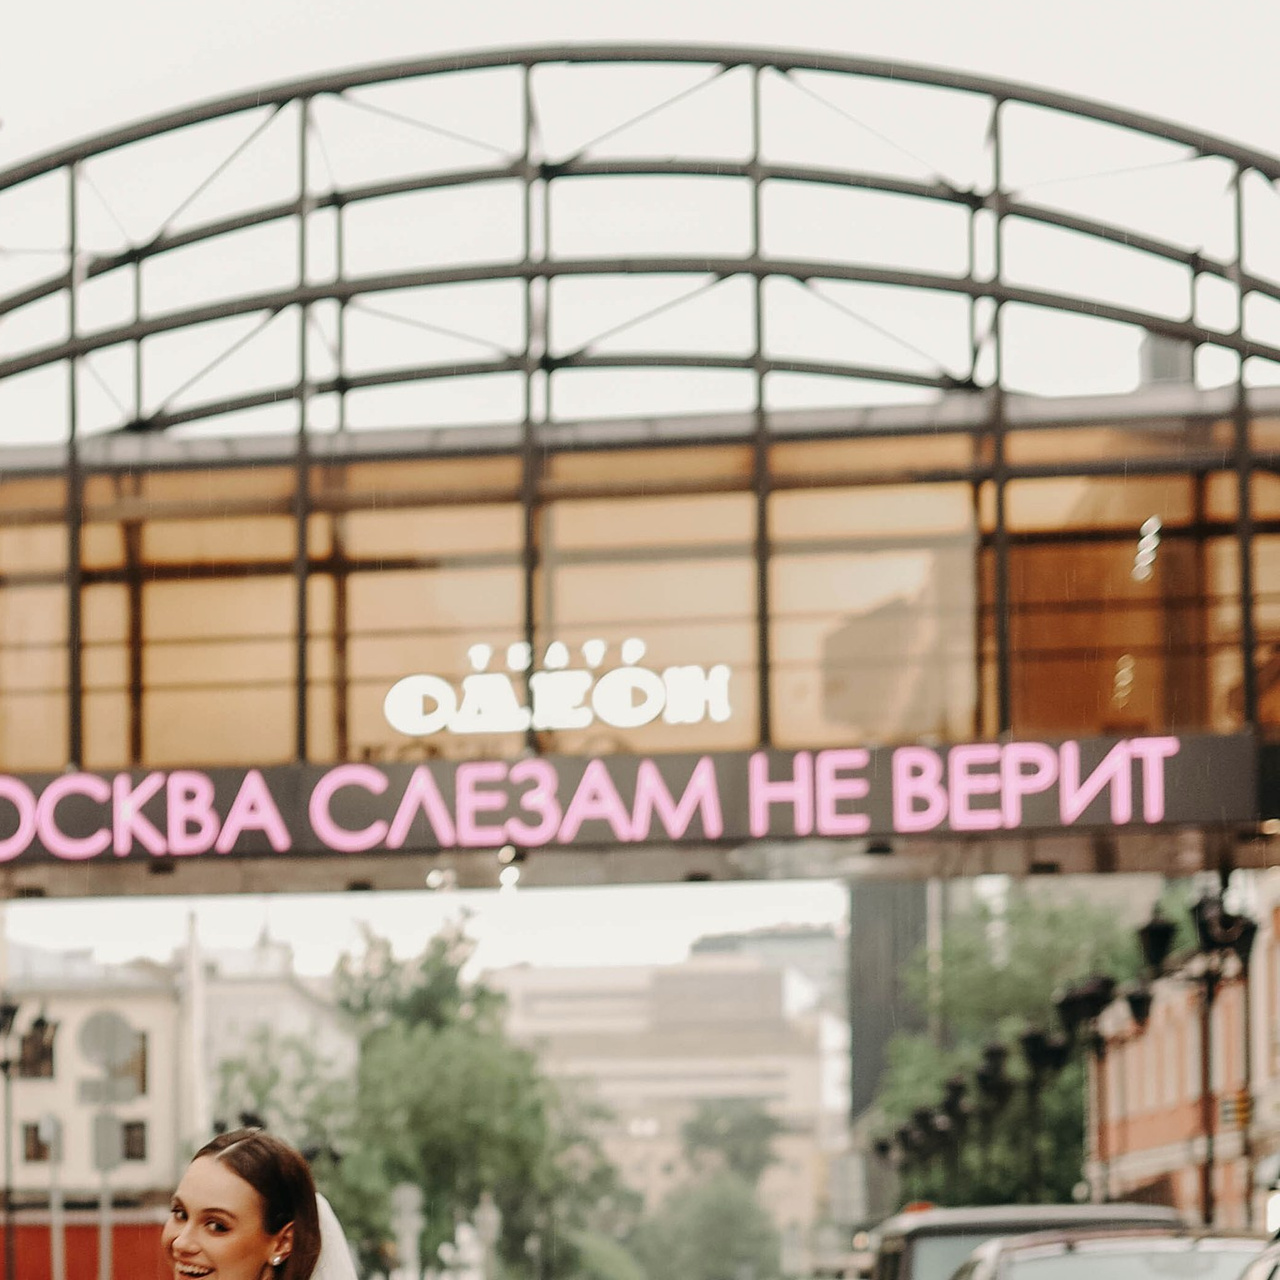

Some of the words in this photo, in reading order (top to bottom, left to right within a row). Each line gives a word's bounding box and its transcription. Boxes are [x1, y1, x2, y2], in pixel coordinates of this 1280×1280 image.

[308, 756, 722, 854] СЛЕЗАМ
[748, 748, 870, 838] НЕ
[892, 736, 1181, 834] ВЕРИТ
